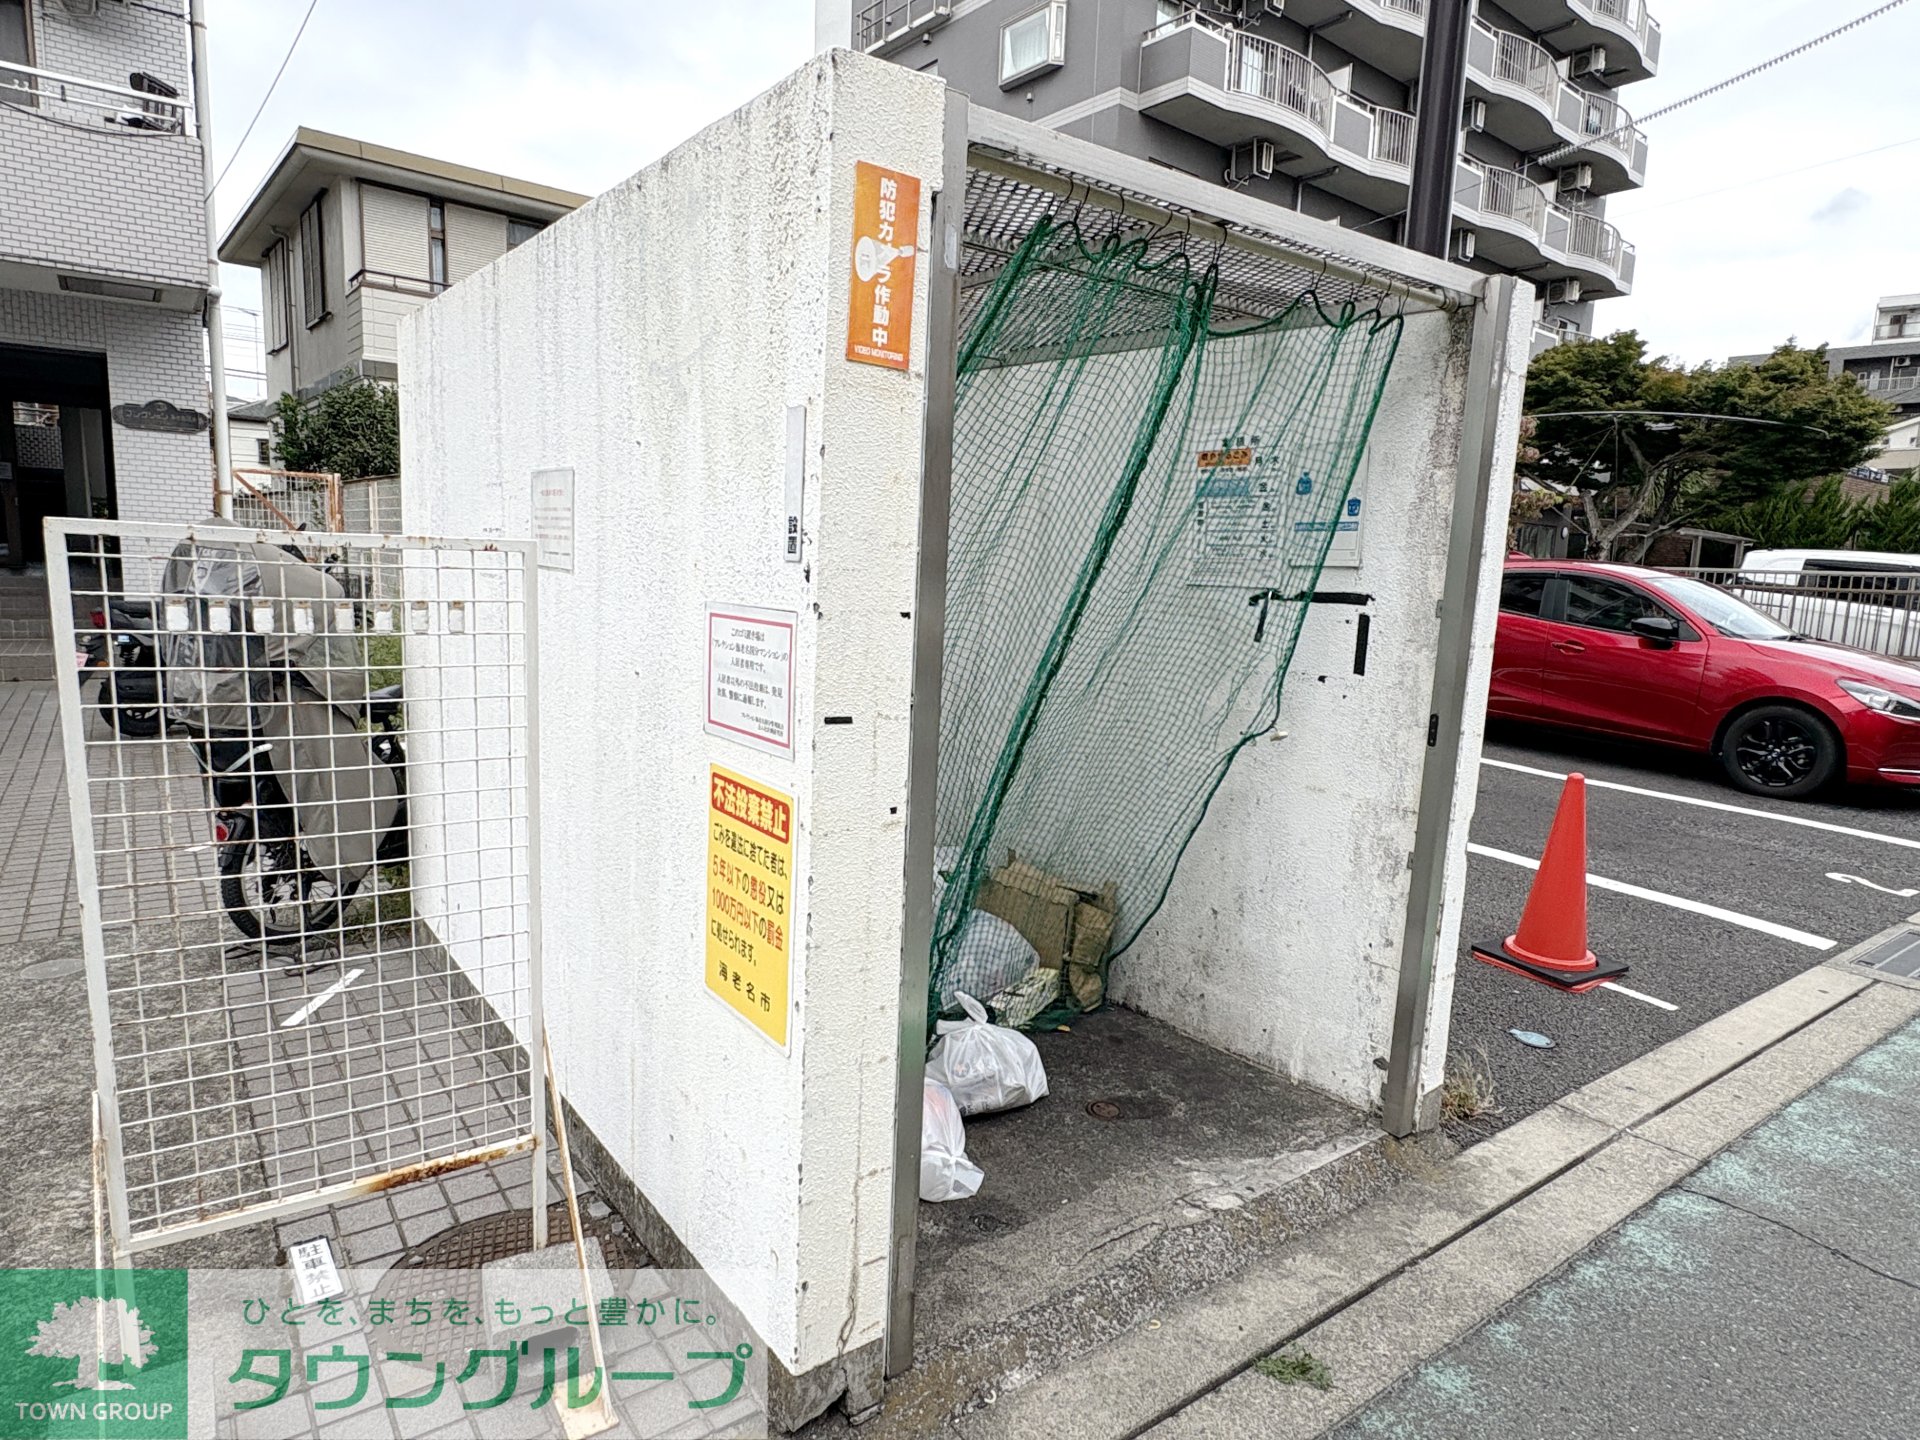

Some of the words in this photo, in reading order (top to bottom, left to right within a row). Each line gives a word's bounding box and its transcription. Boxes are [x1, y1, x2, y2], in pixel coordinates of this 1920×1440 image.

[854, 344, 871, 355] VIDEO
[713, 776, 787, 840] 不法投棄禁止
[714, 822, 788, 880] ごみを違法に捨てた者は、
[712, 854, 785, 915] 5年以下の懲役又は
[711, 918, 757, 967] に処せられます。
[712, 887, 783, 951] 1000万円以下の罰金
[719, 960, 771, 1013] 海老名市
